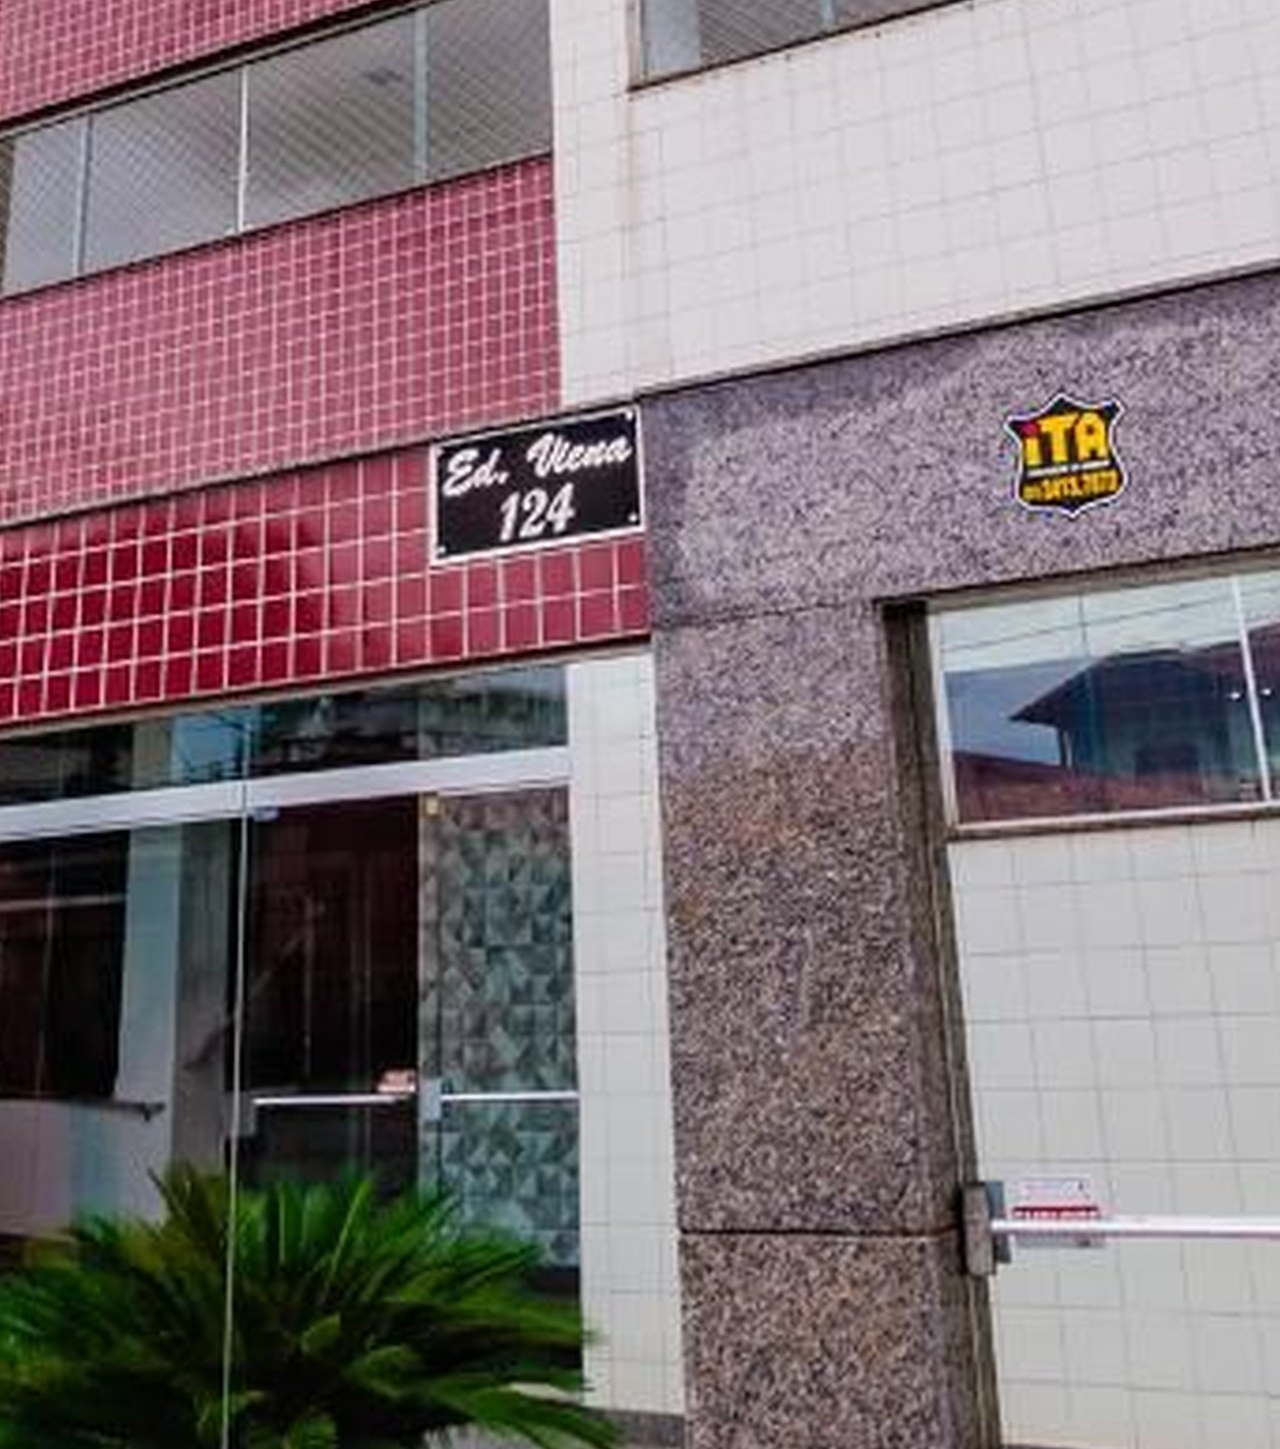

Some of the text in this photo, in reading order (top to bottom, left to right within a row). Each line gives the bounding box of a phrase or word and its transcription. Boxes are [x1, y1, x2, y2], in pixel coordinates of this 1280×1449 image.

[441, 432, 632, 496] Ed. Viena
[500, 483, 575, 541] 124
